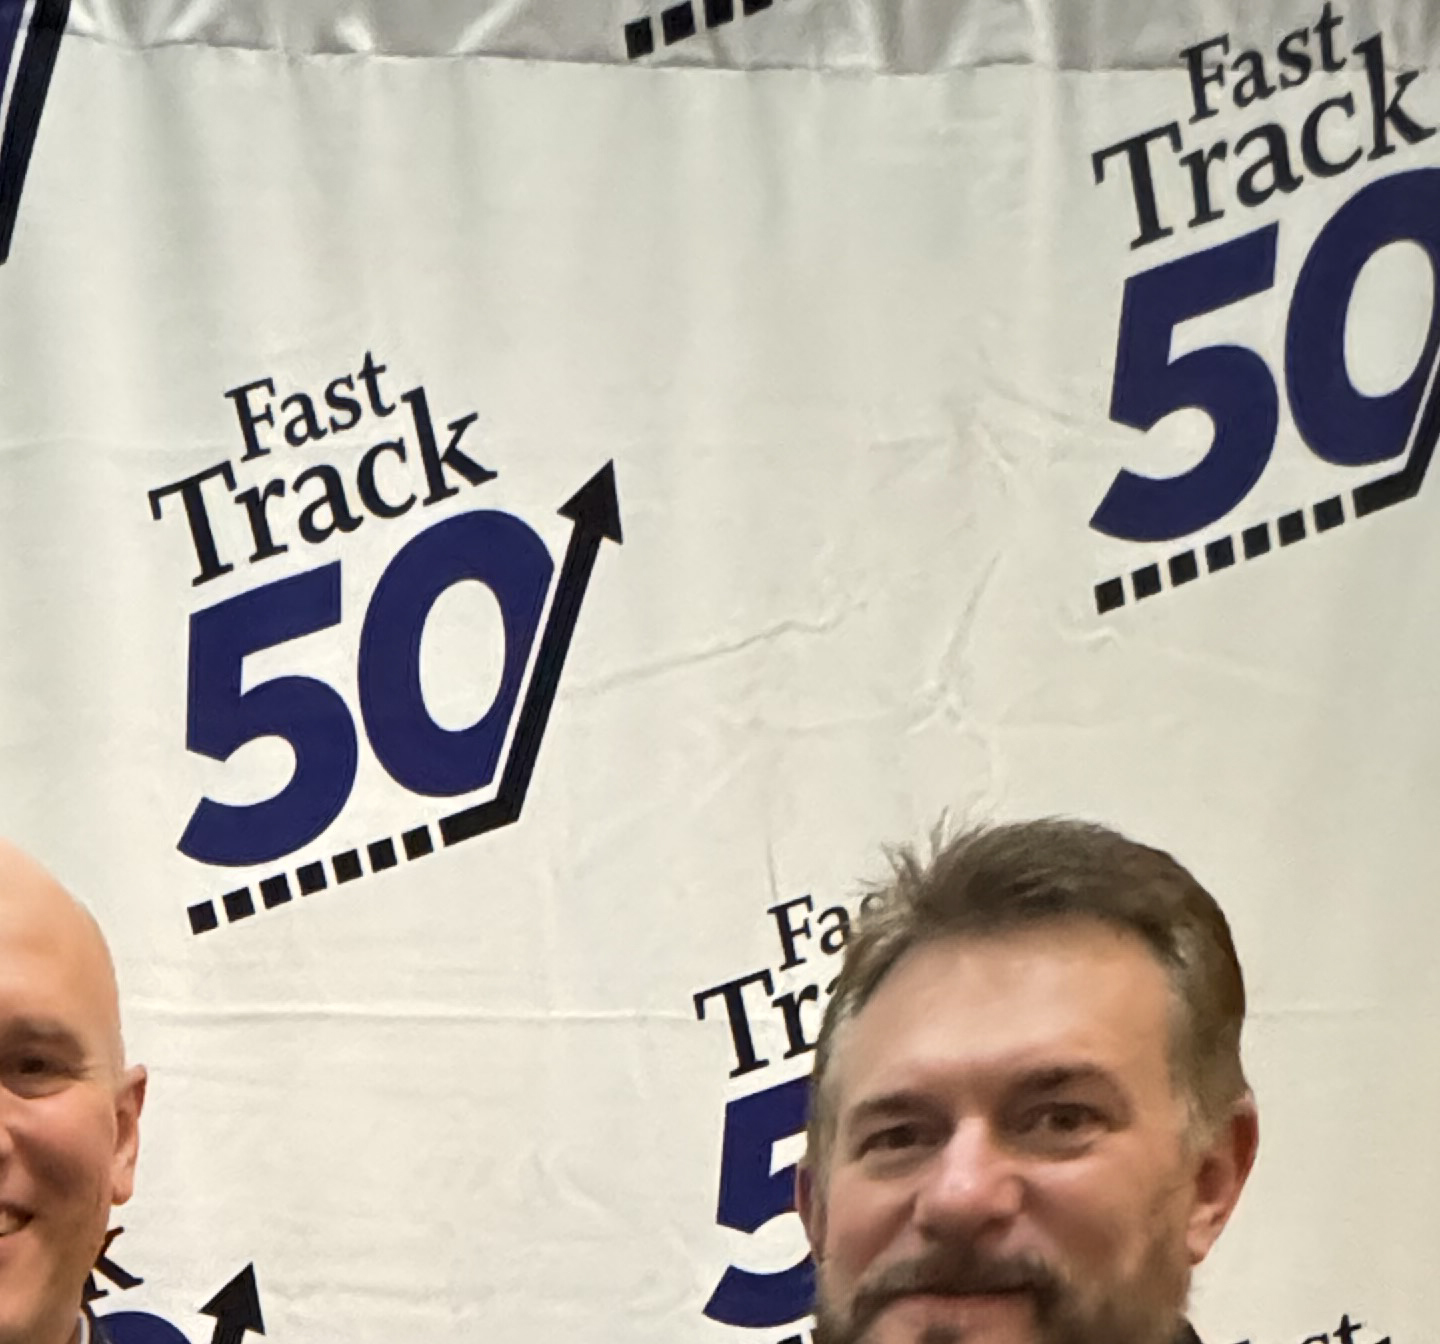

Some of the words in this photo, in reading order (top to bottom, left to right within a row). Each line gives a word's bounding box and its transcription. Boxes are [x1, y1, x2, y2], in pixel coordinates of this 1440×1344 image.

[1091, 32, 1438, 251] Track
[1180, 1, 1350, 125] Fast
[224, 350, 397, 463] Fast
[1088, 166, 1440, 543] 50
[148, 386, 498, 587] Track
[176, 509, 555, 868] 50
[767, 895, 851, 972] Fa
[702, 1074, 818, 1329] 5
